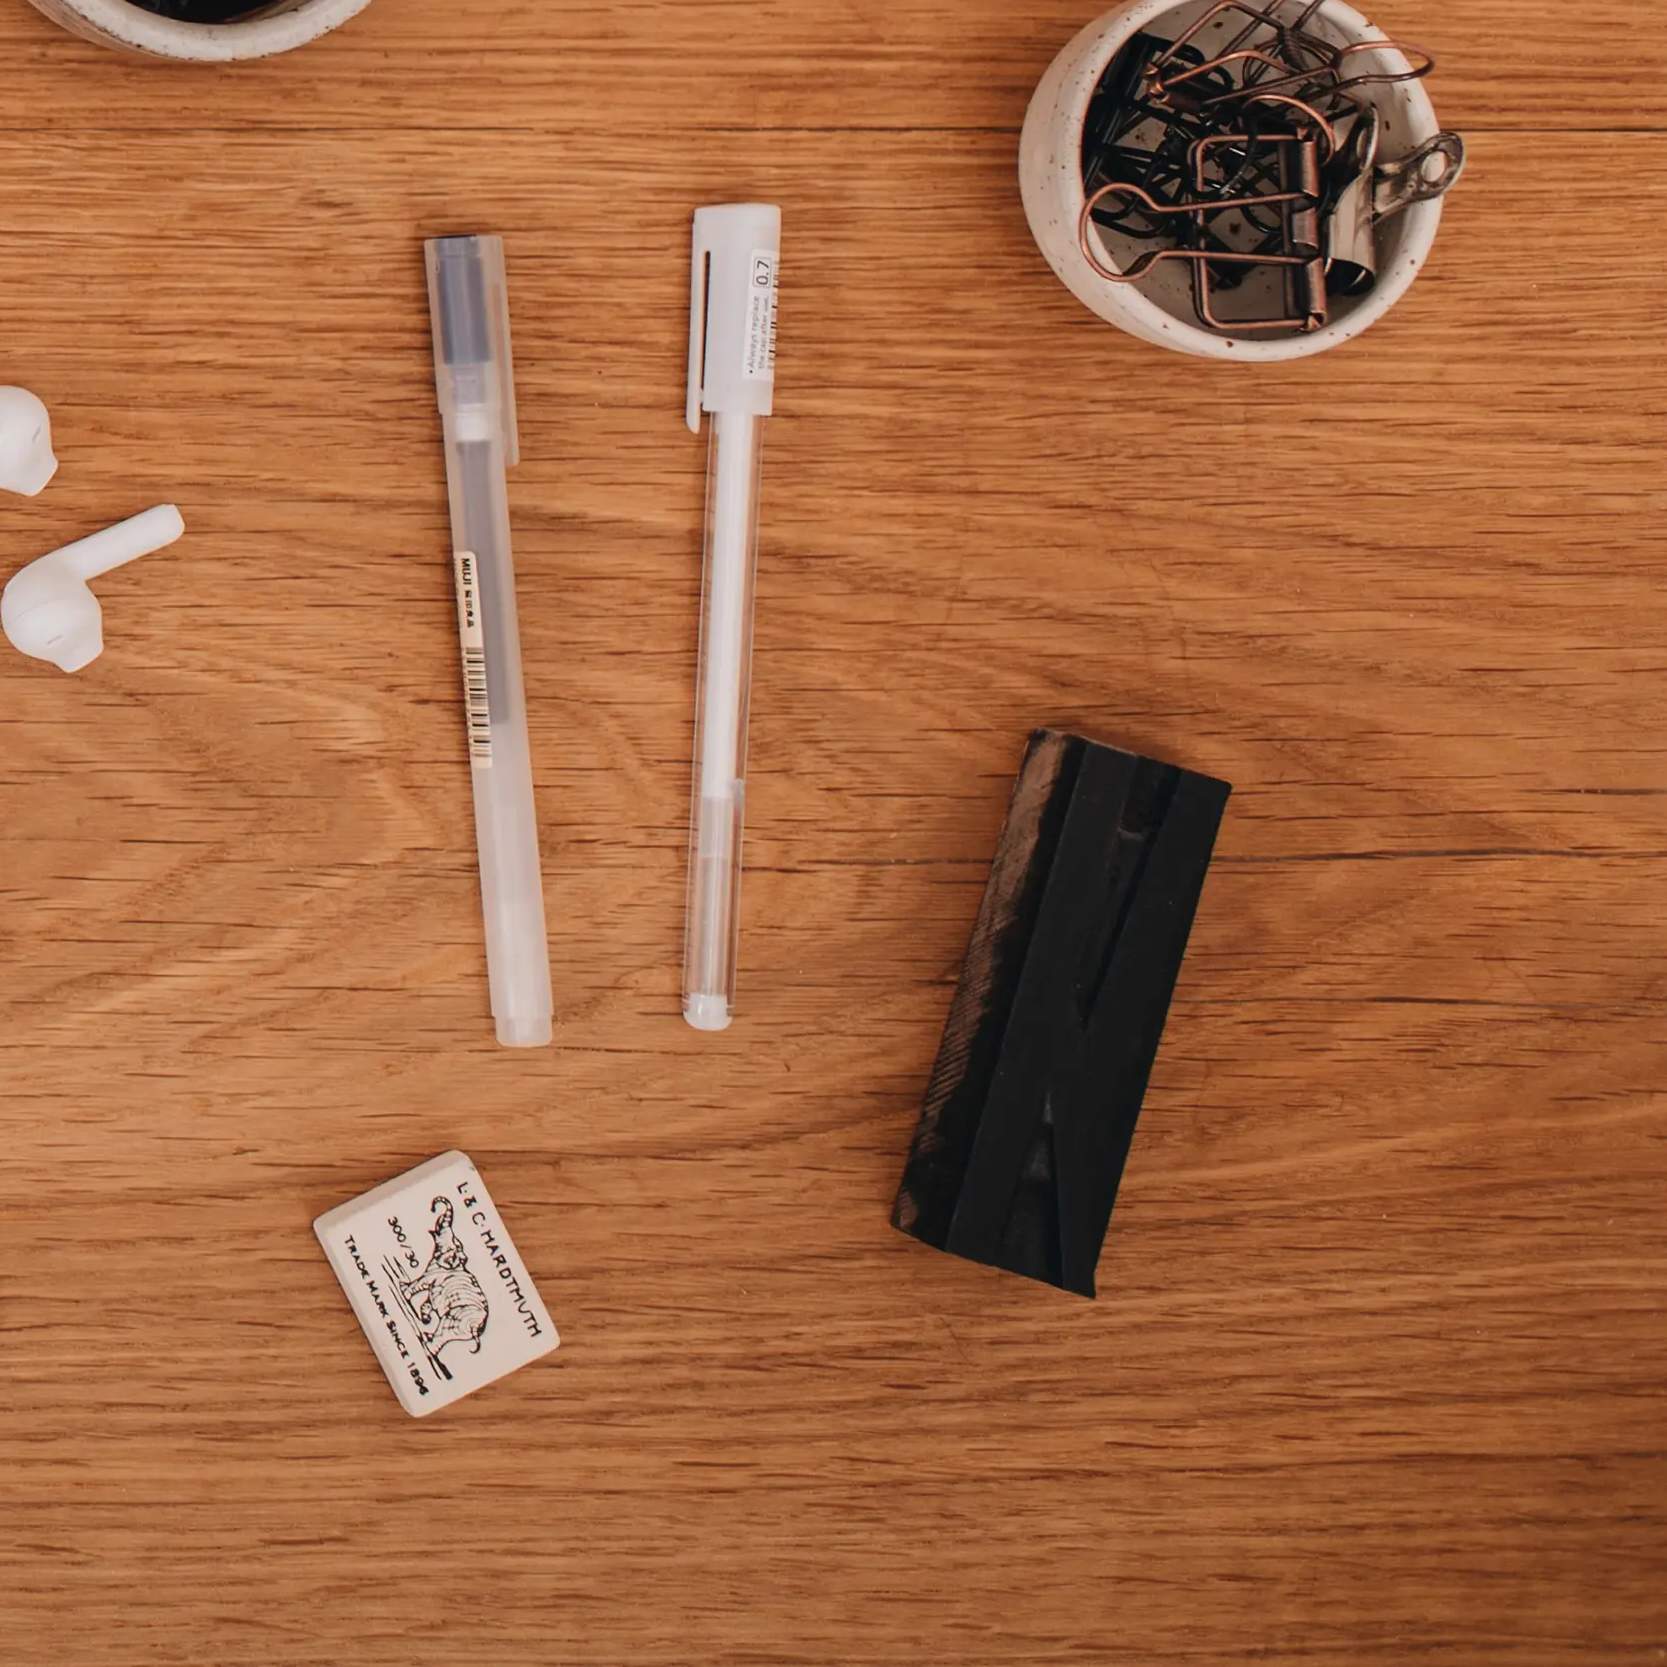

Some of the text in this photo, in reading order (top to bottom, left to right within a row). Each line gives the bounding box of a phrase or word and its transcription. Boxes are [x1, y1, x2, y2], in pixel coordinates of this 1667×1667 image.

[756, 260, 769, 285] 0.7
[461, 558, 472, 585] MUJI
[387, 1216, 419, 1269] 300/30
[480, 1229, 543, 1338] HARDTMUTH
